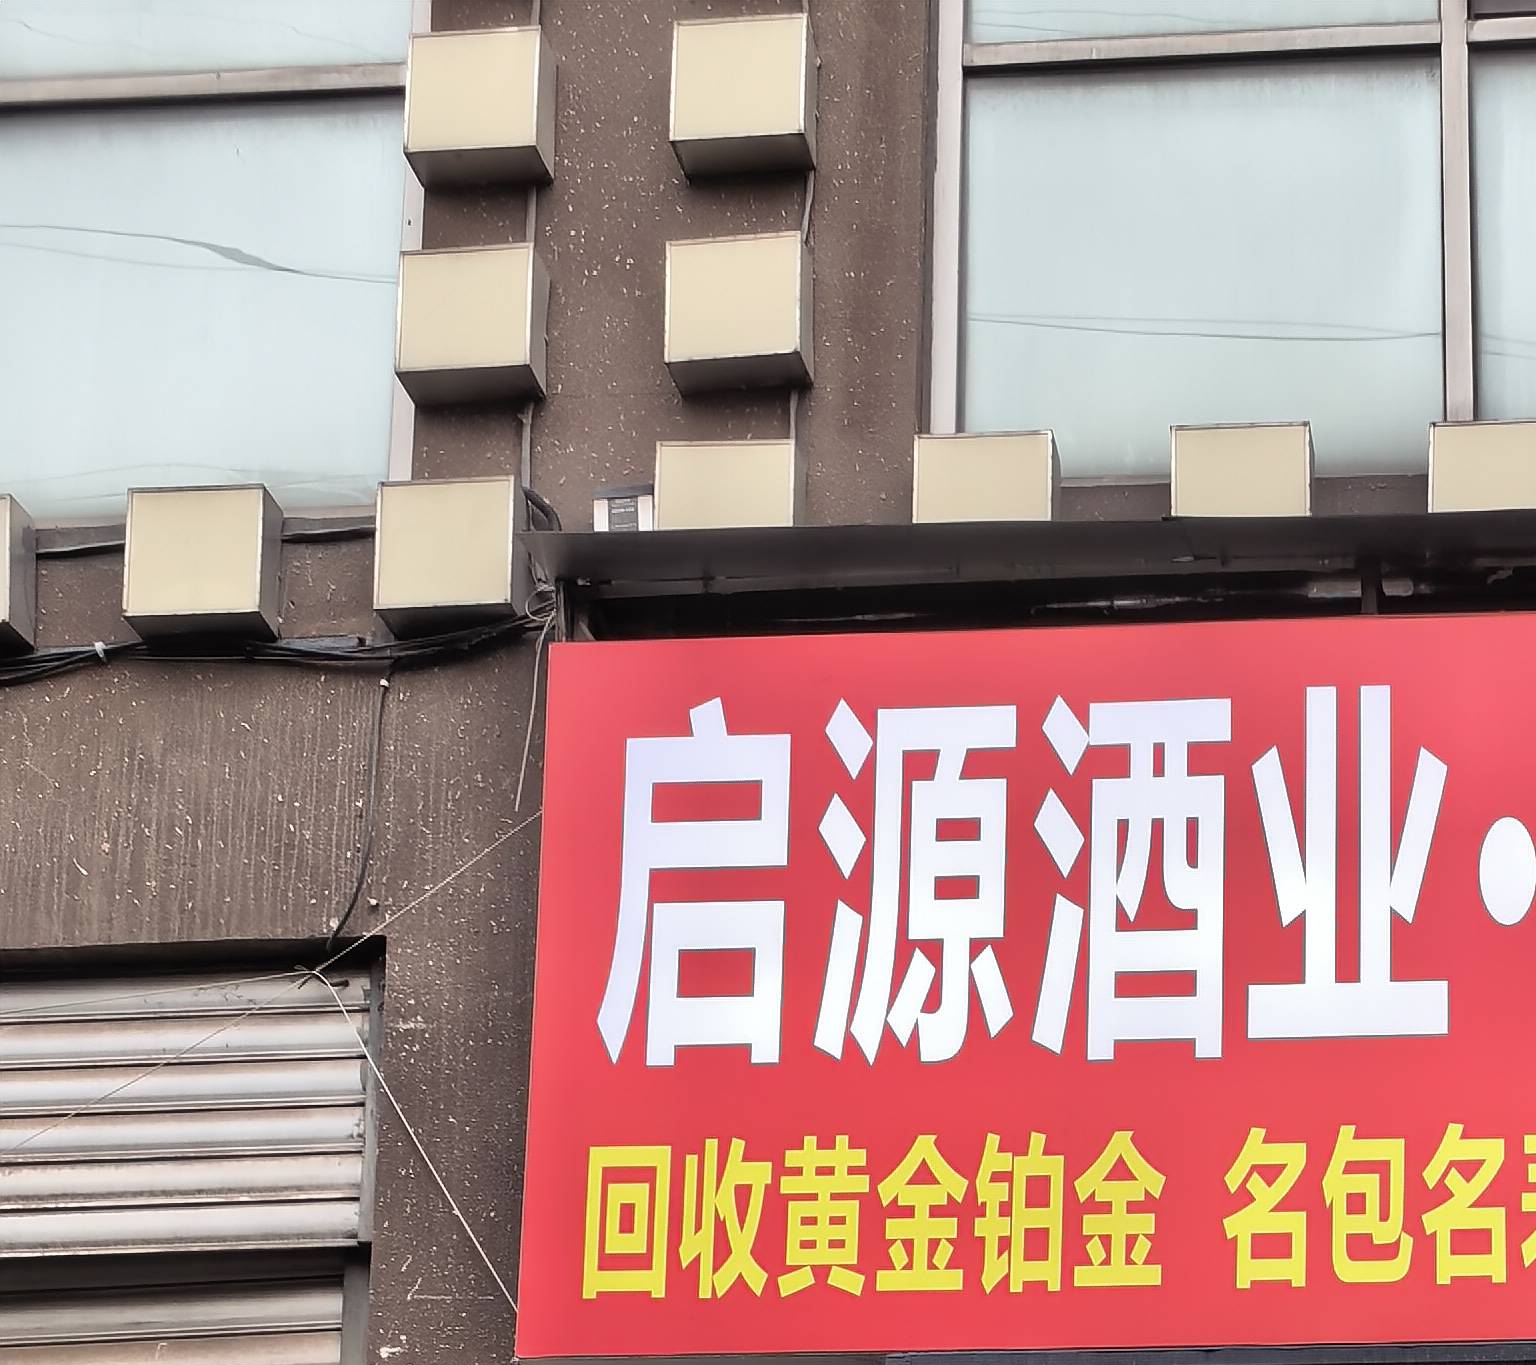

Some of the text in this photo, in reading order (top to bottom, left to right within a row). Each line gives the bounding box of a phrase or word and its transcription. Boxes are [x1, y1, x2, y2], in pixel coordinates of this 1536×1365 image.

[583, 1130, 1166, 1298] 回收黄金铂金
